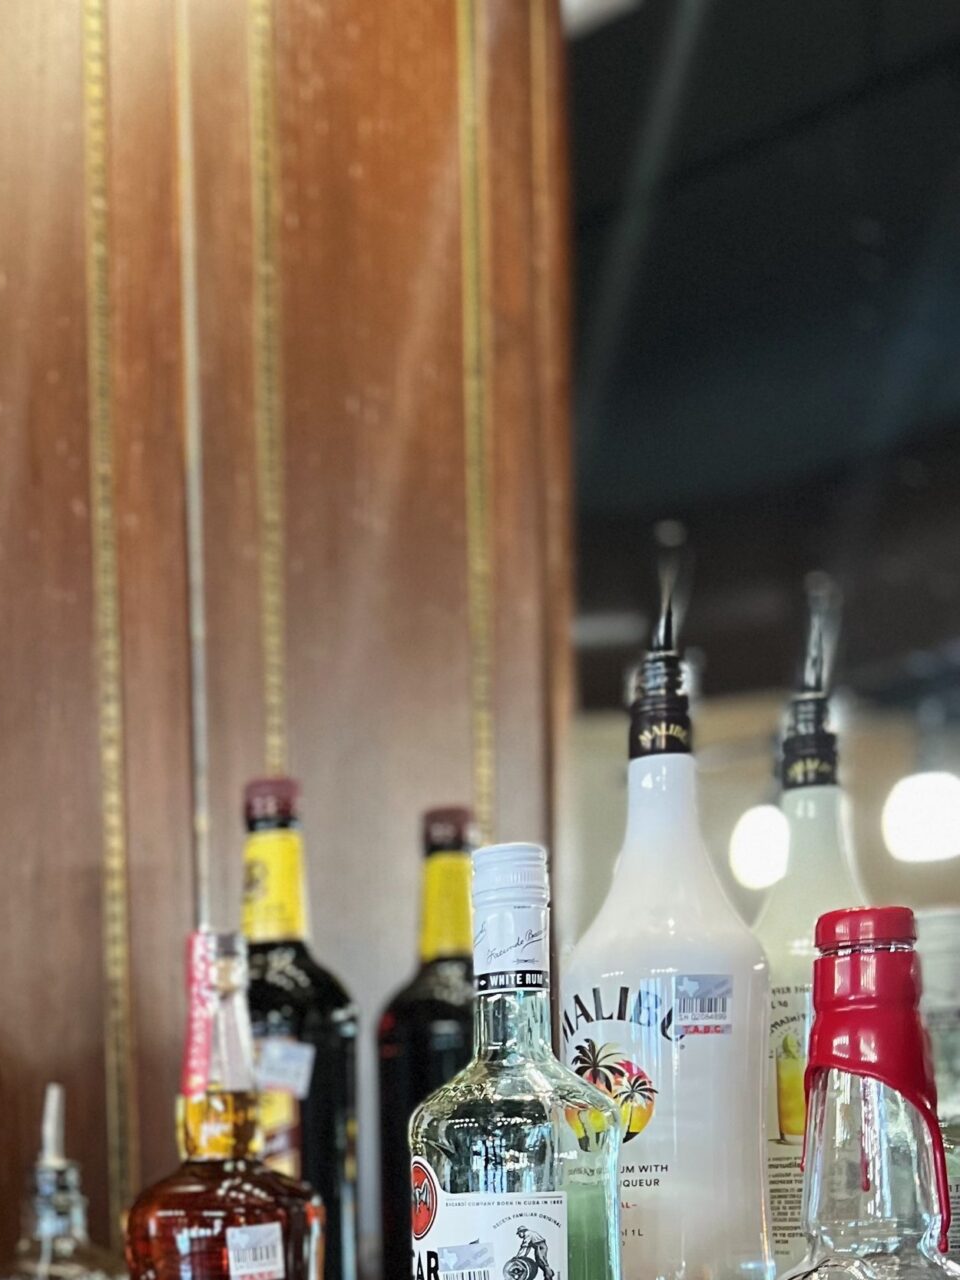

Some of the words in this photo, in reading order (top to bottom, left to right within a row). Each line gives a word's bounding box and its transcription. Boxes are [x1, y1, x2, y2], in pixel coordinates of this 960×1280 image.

[489, 973, 522, 987] WHITE
[525, 973, 543, 985] RUM
[638, 1165, 669, 1173] WITH
